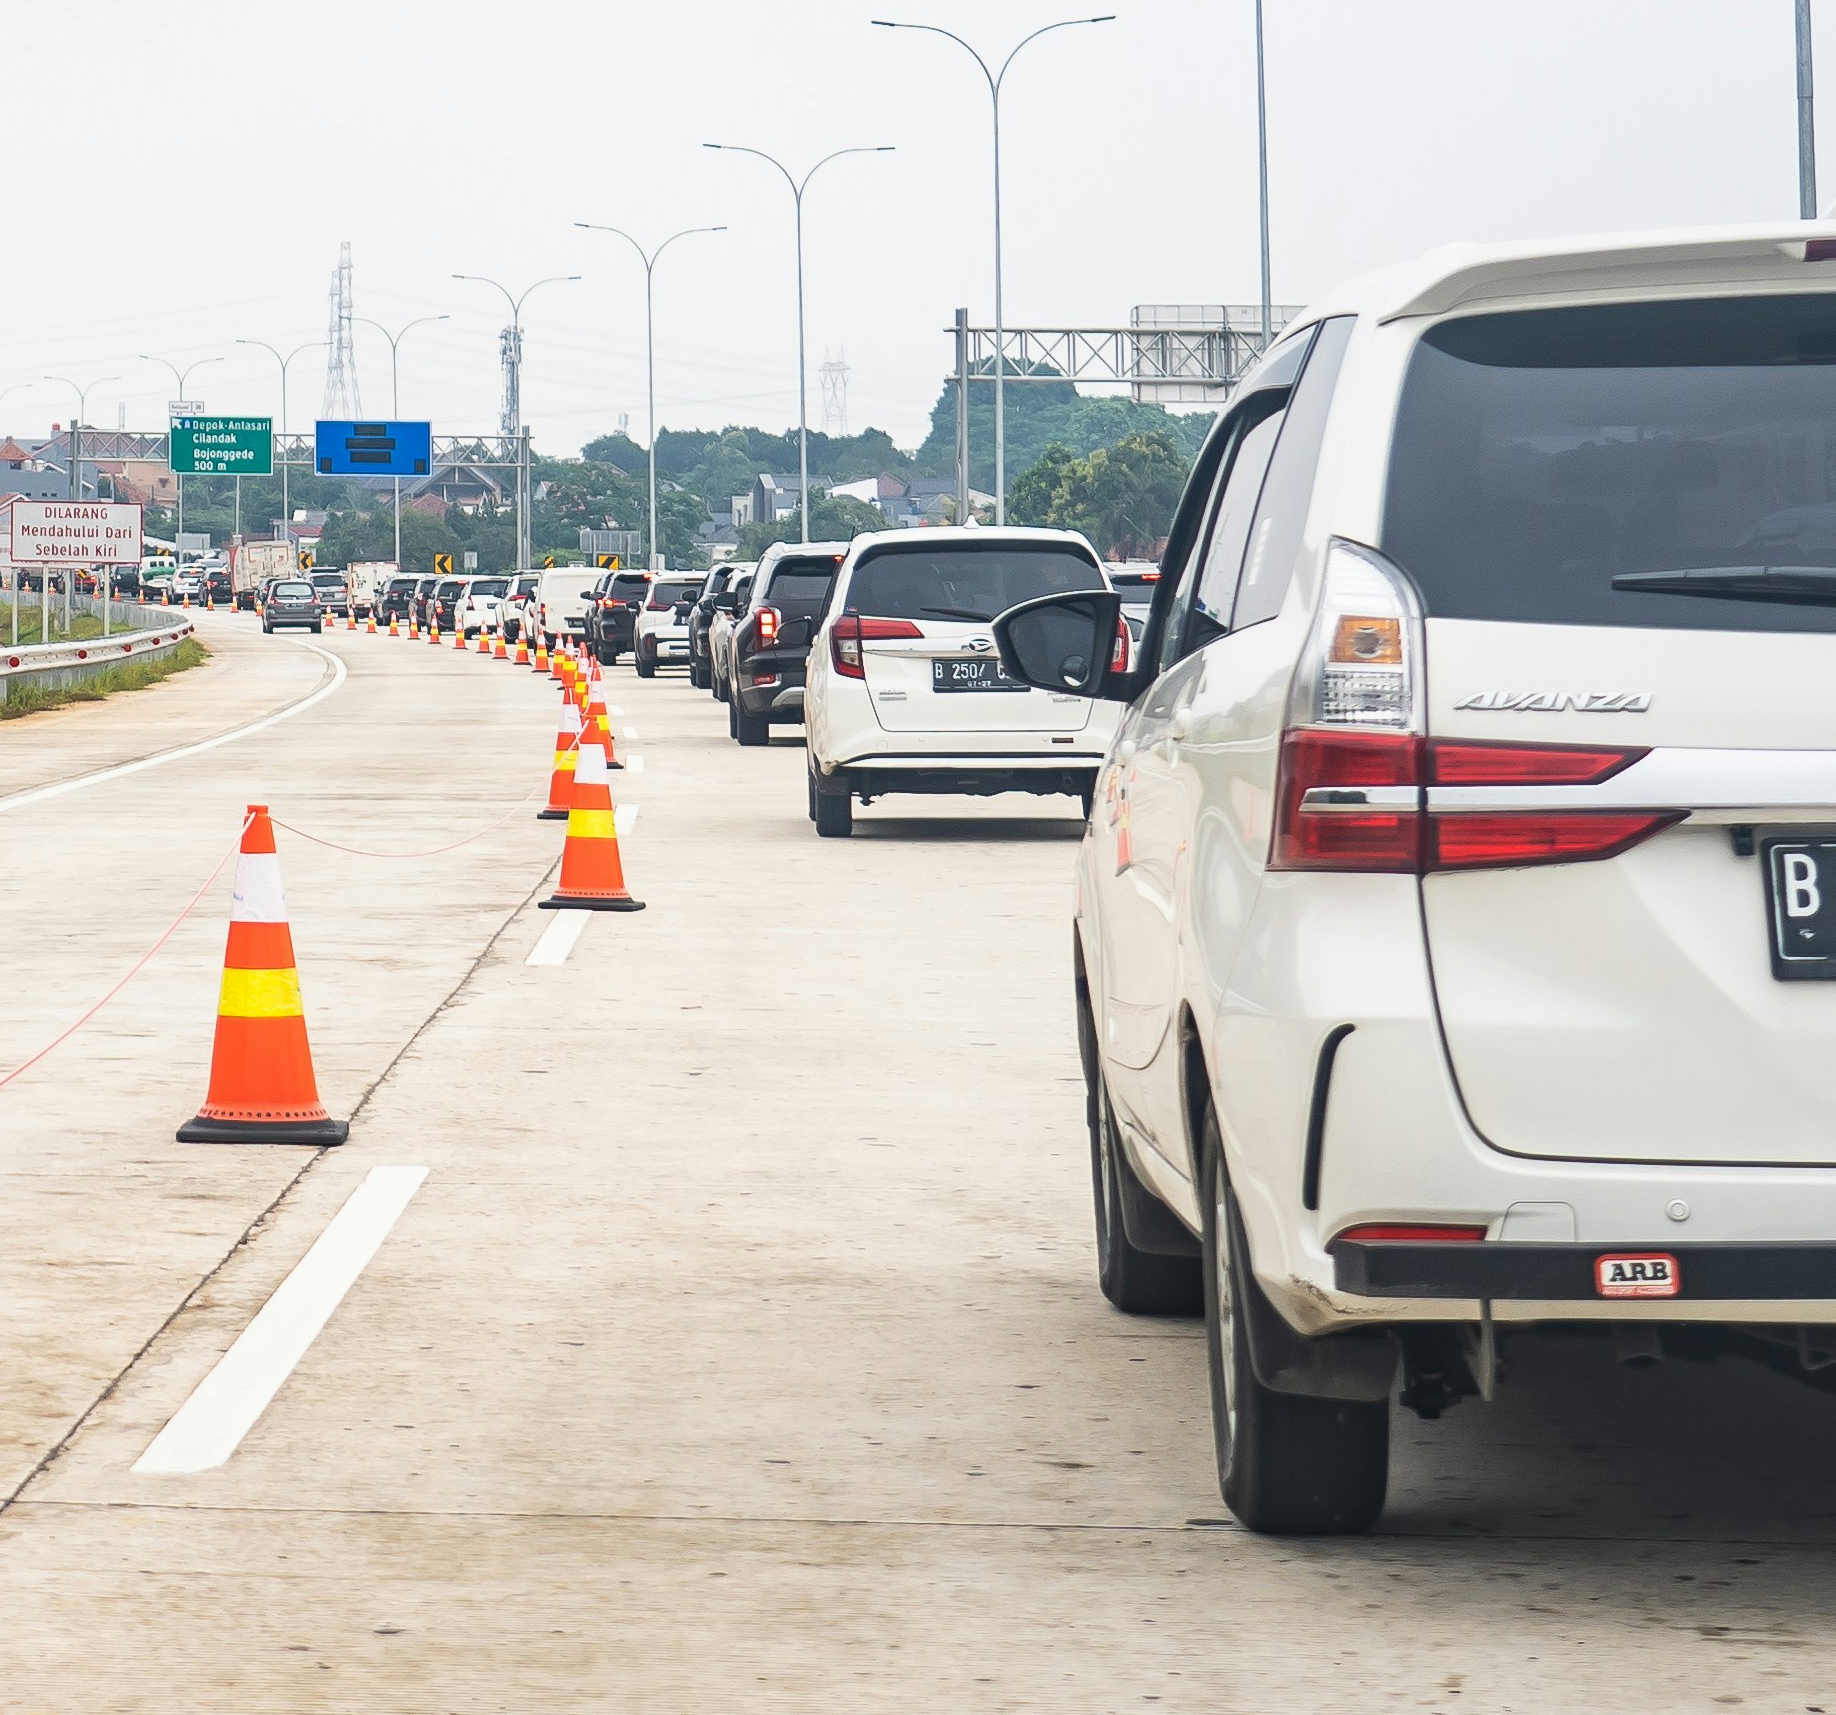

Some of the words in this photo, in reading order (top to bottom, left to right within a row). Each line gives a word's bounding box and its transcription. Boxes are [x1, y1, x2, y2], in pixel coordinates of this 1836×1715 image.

[192, 433, 237, 444] Cilandak
[193, 448, 255, 461] Bojonggede
[194, 461, 214, 471] 500
[217, 462, 227, 471] m
[44, 506, 108, 520] DILARANG
[21, 524, 99, 539] Mendahului
[105, 525, 132, 539] Dari
[35, 543, 89, 557] Sebelah
[95, 544, 117, 557] Kiri
[934, 663, 944, 679] B
[1452, 690, 1654, 712] AVANZA
[1783, 853, 1820, 918] B
[1609, 1261, 1669, 1282] ARB
